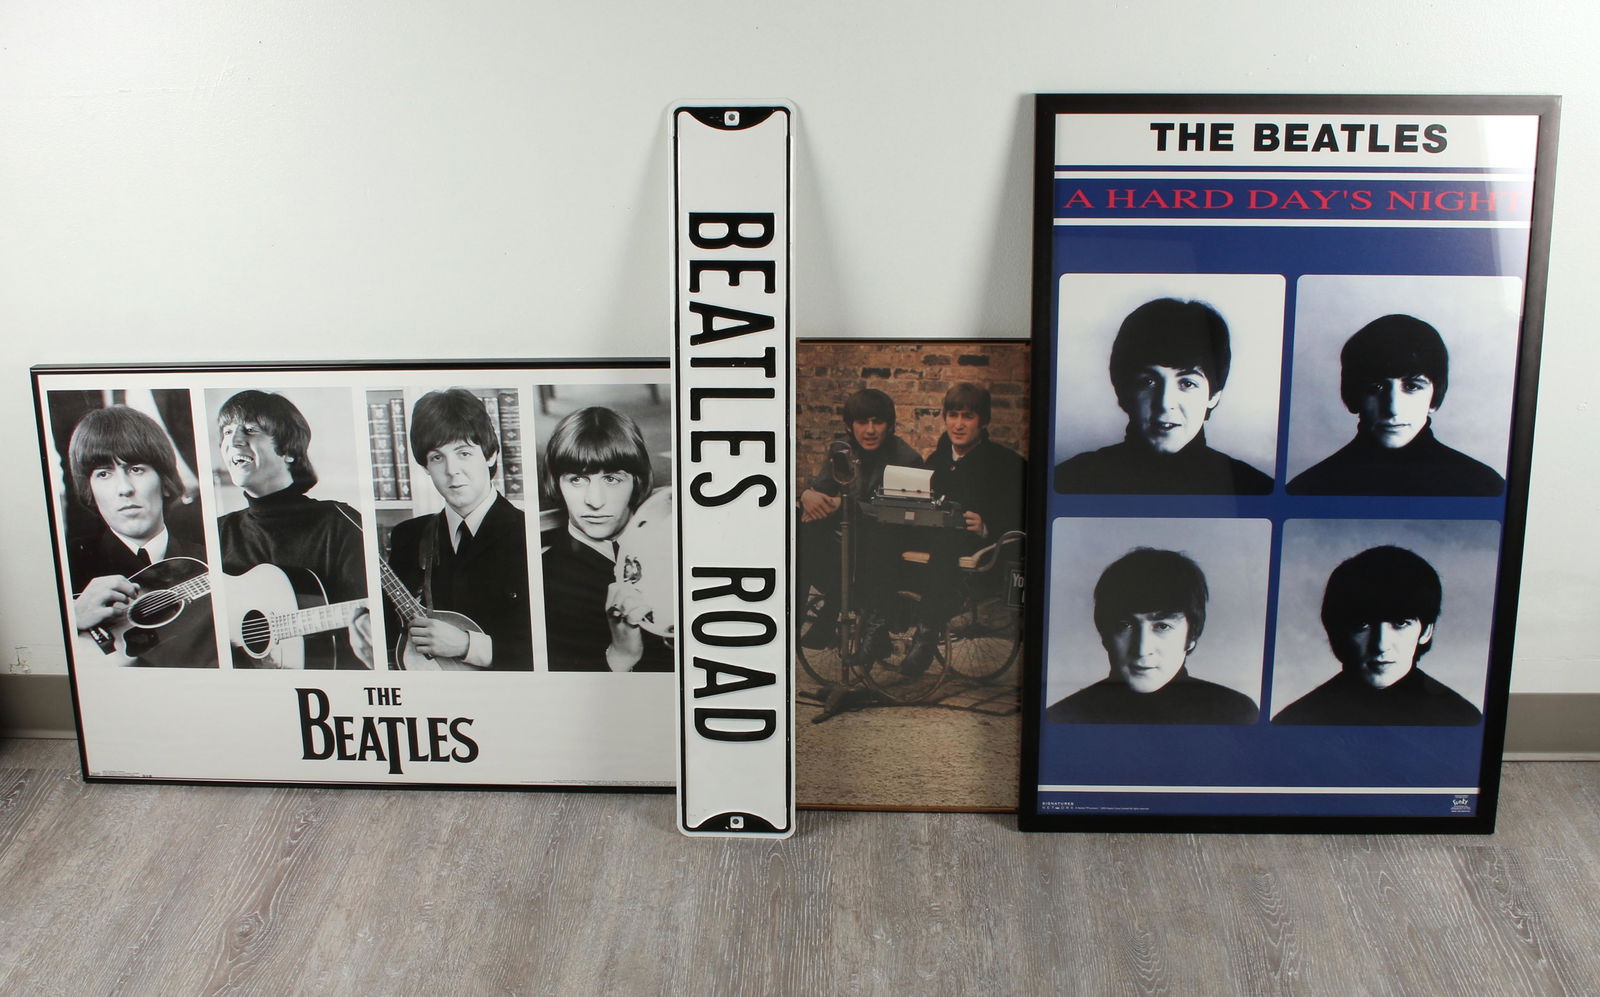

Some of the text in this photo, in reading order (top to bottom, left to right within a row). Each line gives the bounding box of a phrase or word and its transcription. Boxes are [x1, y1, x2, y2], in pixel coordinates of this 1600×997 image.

[1150, 122, 1448, 154] THE BEATLES
[1064, 189, 1529, 212] A HARD DAY'S NIGHT
[688, 212, 777, 742] BEATLES ROAD
[363, 687, 402, 706] THE
